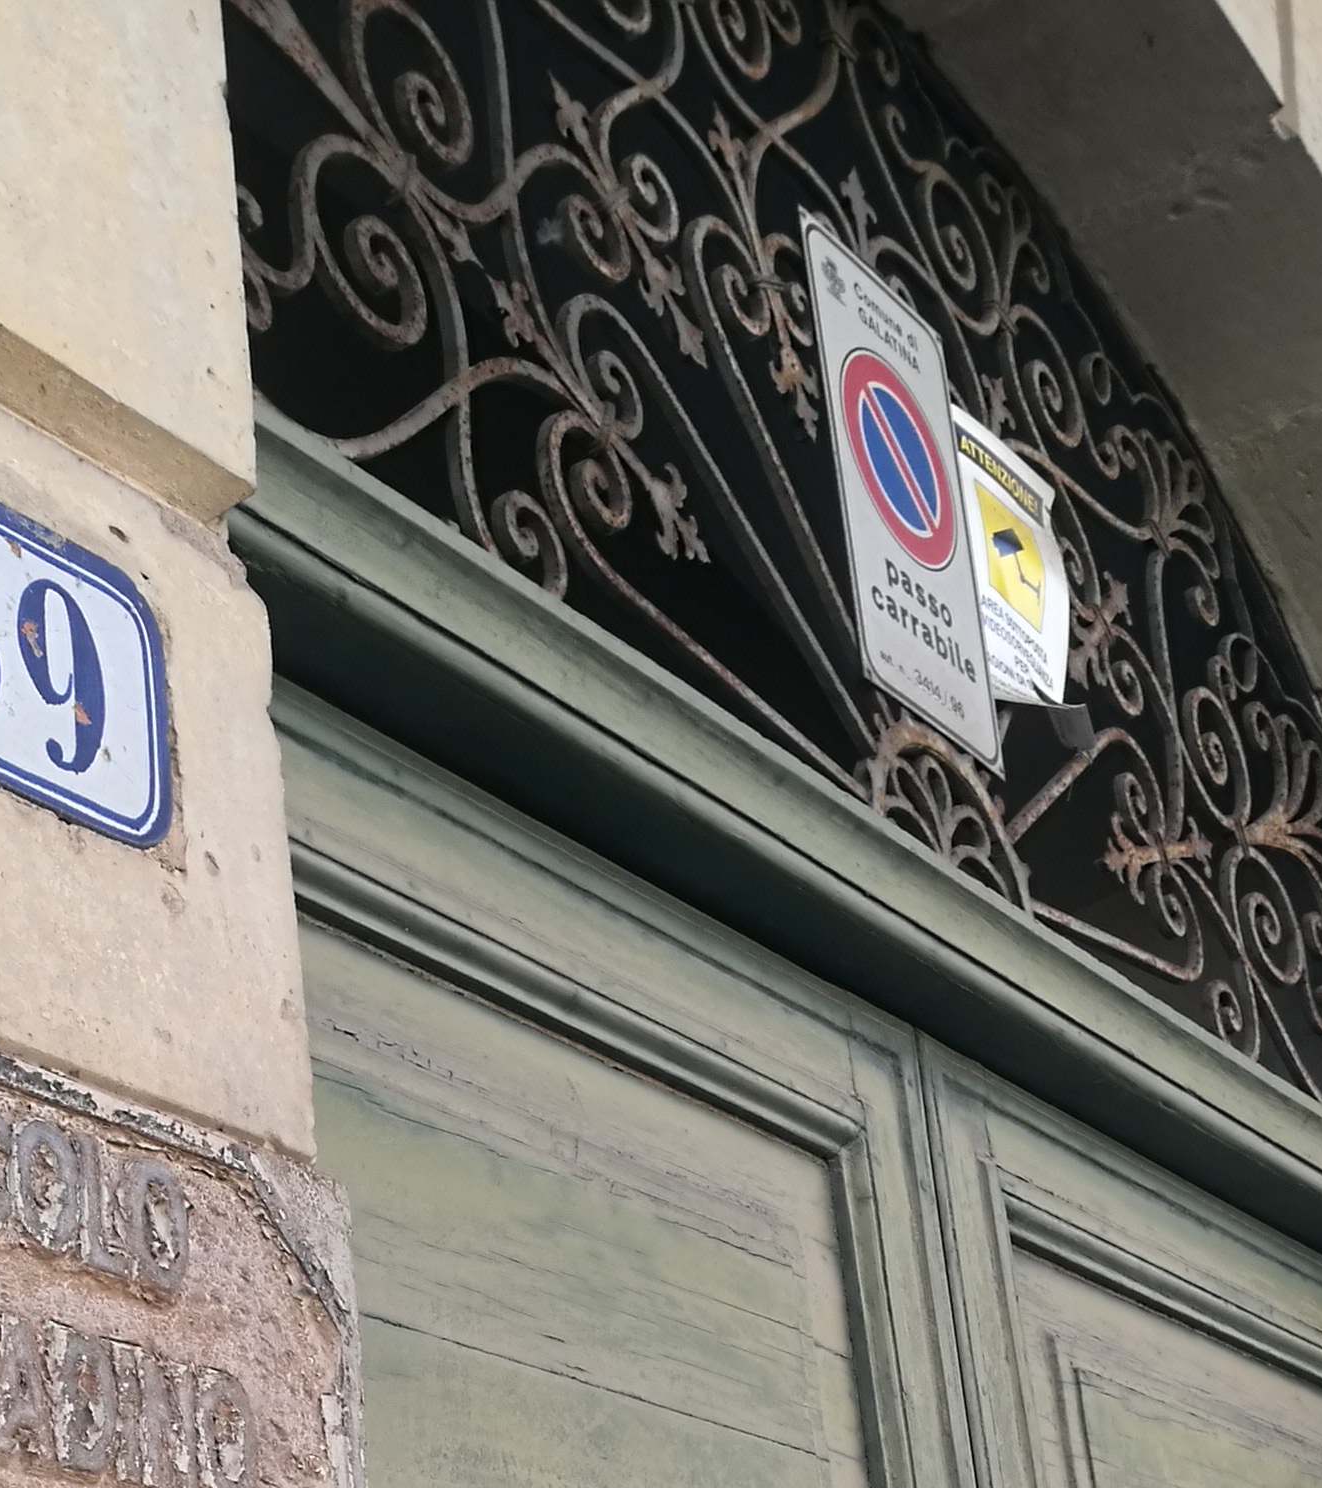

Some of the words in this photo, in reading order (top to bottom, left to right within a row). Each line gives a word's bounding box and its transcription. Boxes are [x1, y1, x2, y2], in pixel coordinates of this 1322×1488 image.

[854, 282, 903, 337] Comune
[907, 333, 919, 352] di
[858, 307, 921, 374] GALATINA
[961, 435, 1039, 515] ATTENZIONE!
[885, 558, 952, 628] passo
[871, 586, 976, 684] carrabile
